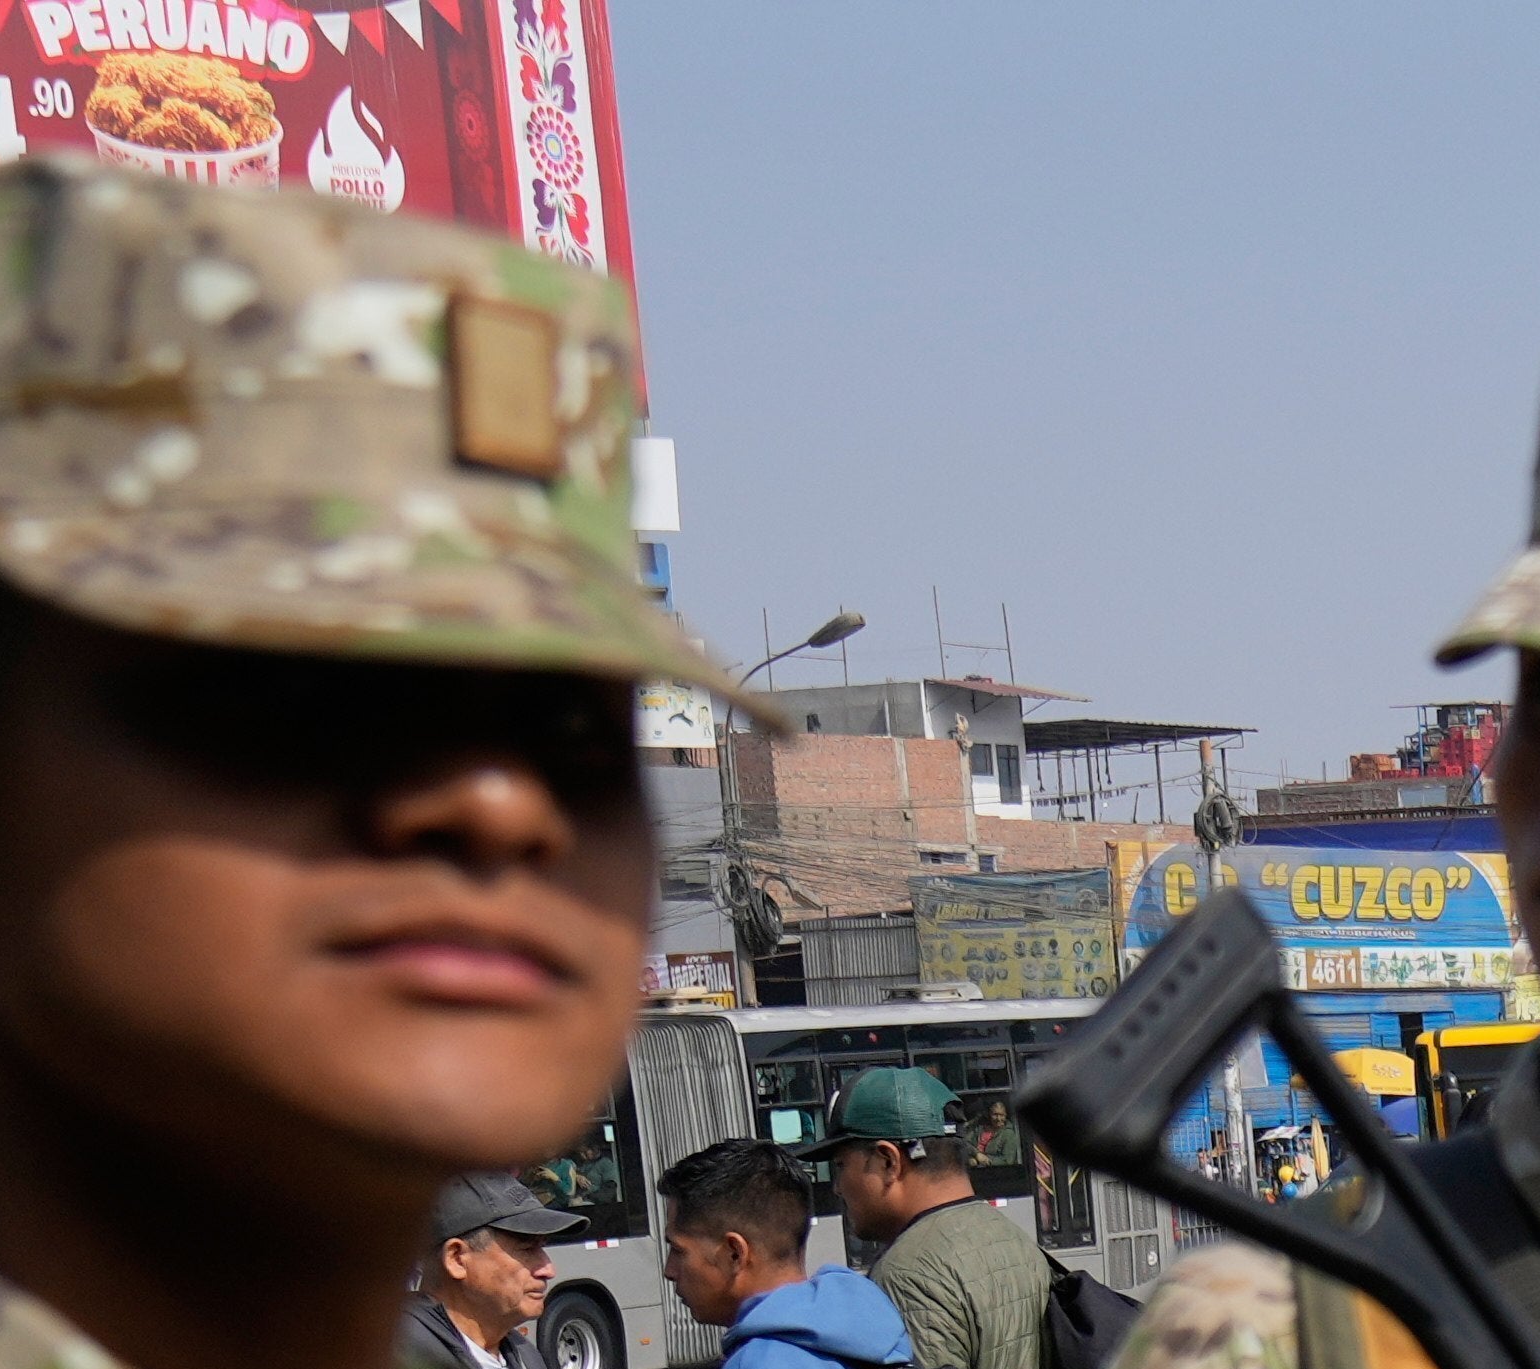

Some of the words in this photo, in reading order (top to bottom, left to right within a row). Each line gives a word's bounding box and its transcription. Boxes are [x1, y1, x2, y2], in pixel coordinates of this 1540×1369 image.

[27, 0, 310, 74] PERUANO
[330, 179, 384, 196] POLLO
[670, 963, 734, 992] IMPERIAL
[1312, 957, 1357, 985] 4611
